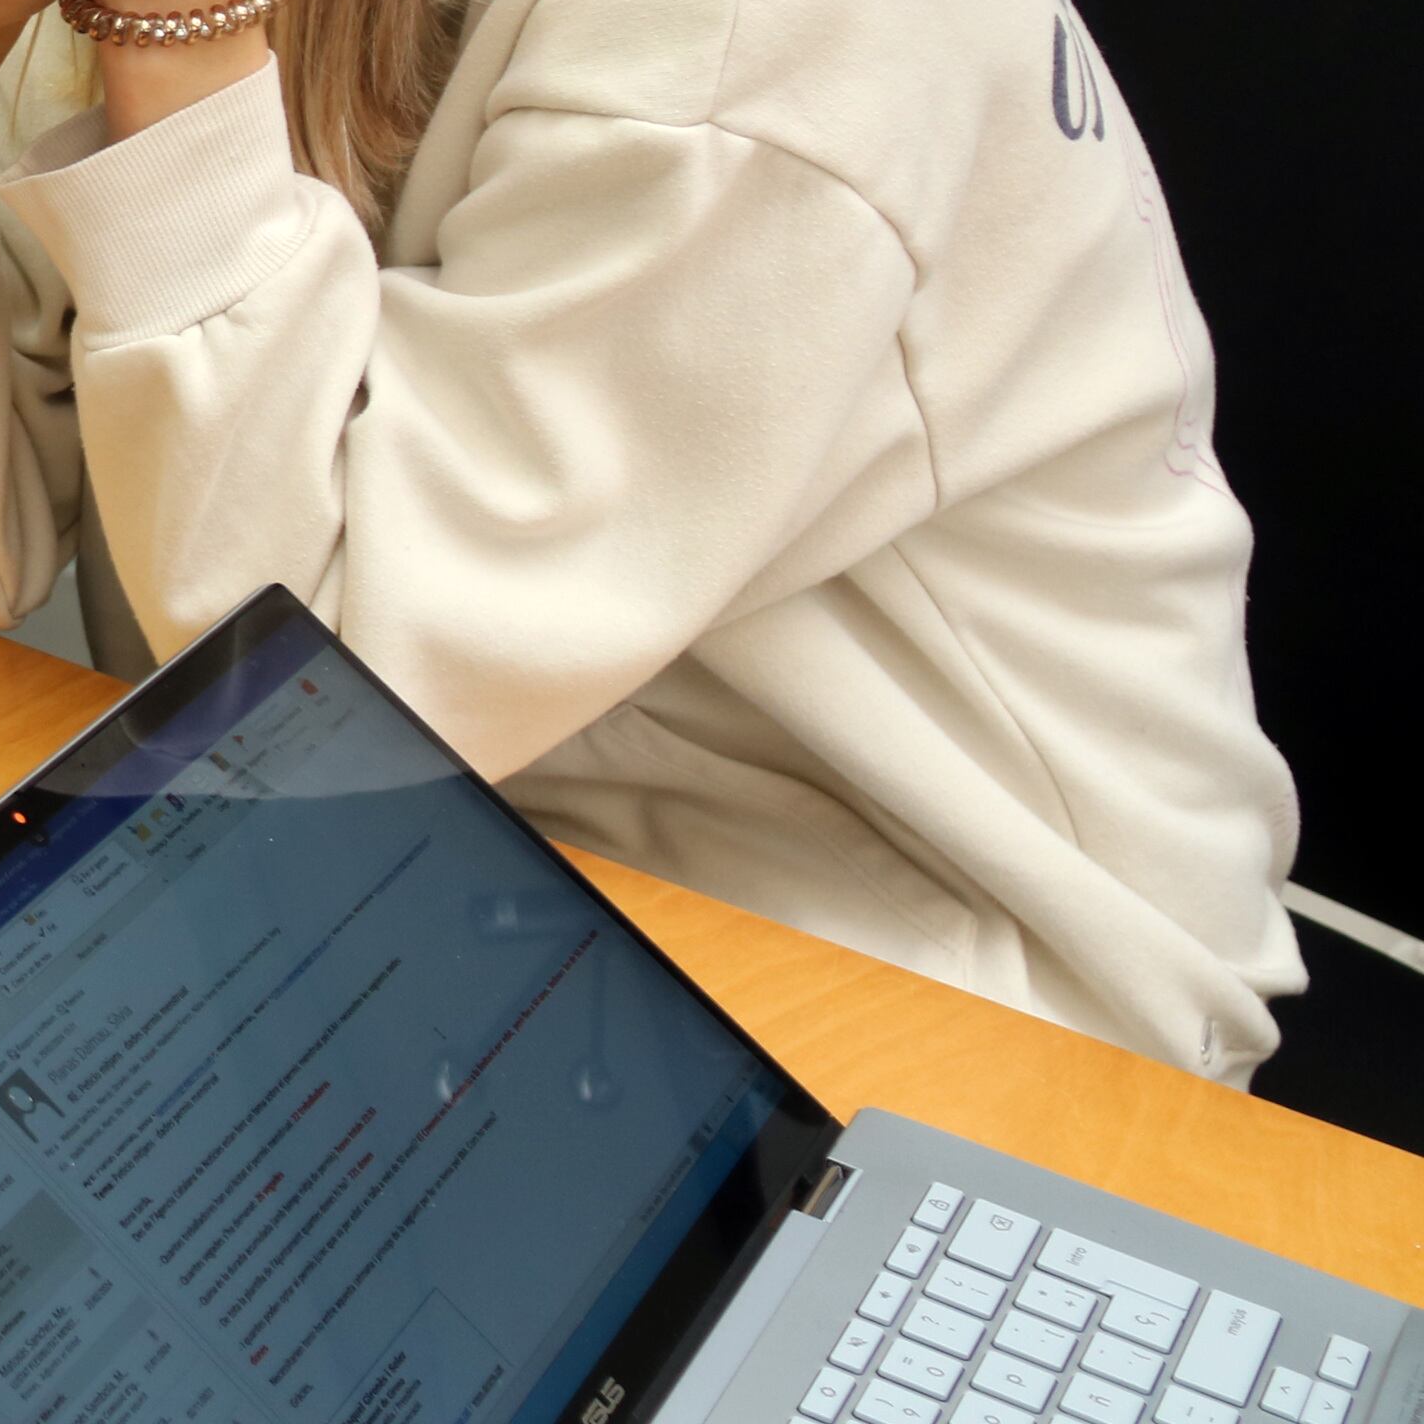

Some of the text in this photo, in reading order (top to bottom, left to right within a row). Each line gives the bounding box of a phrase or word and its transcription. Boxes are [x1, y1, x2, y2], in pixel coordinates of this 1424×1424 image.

[156, 983, 190, 1017] menstrual
[47, 1052, 81, 1086] Planas
[1064, 1245, 1088, 1267] intro
[1226, 1307, 1249, 1338] mayús
[360, 1371, 390, 1408] Gironès
